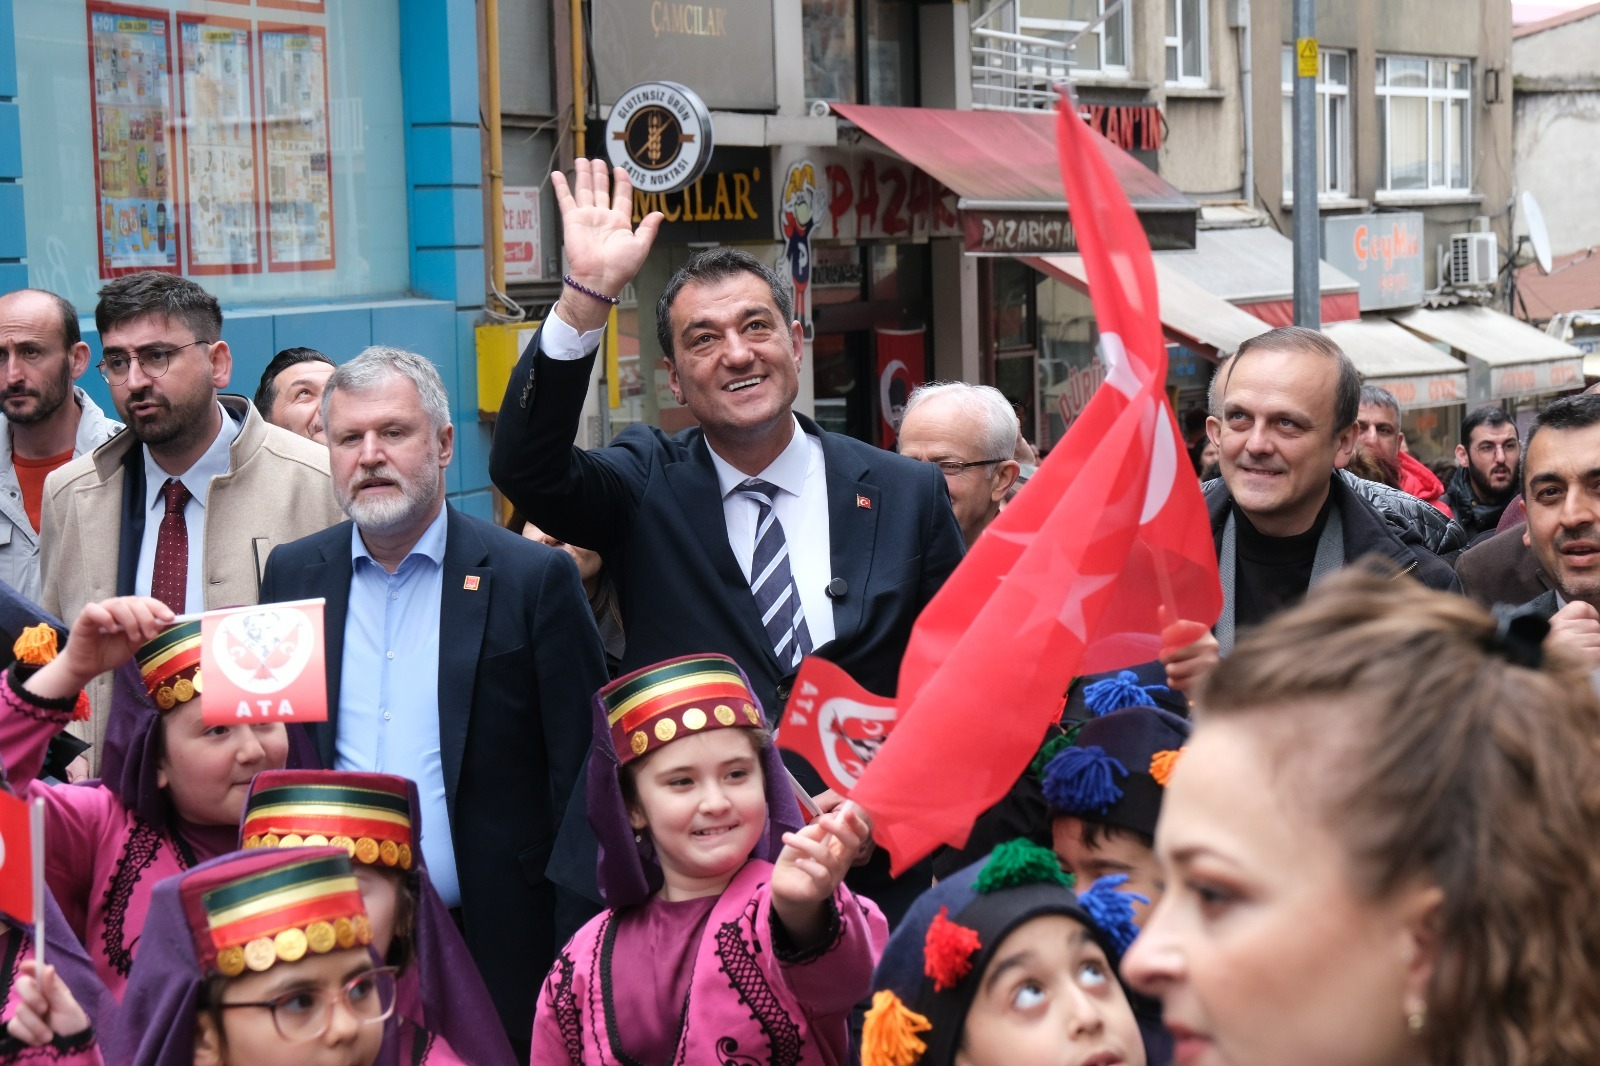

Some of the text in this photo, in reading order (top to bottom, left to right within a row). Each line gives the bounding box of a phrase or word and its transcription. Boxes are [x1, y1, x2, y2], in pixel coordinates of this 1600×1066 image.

[651, 1, 726, 38] ÇAMCILAR
[618, 90, 690, 121] GLUTENSİZ ÜRÜN
[1080, 104, 1162, 151] KAN'IN
[650, 159, 689, 185] NOKTASI
[632, 172, 758, 222] MCILAR
[235, 699, 295, 718] ATA
[788, 680, 819, 726] ATA
